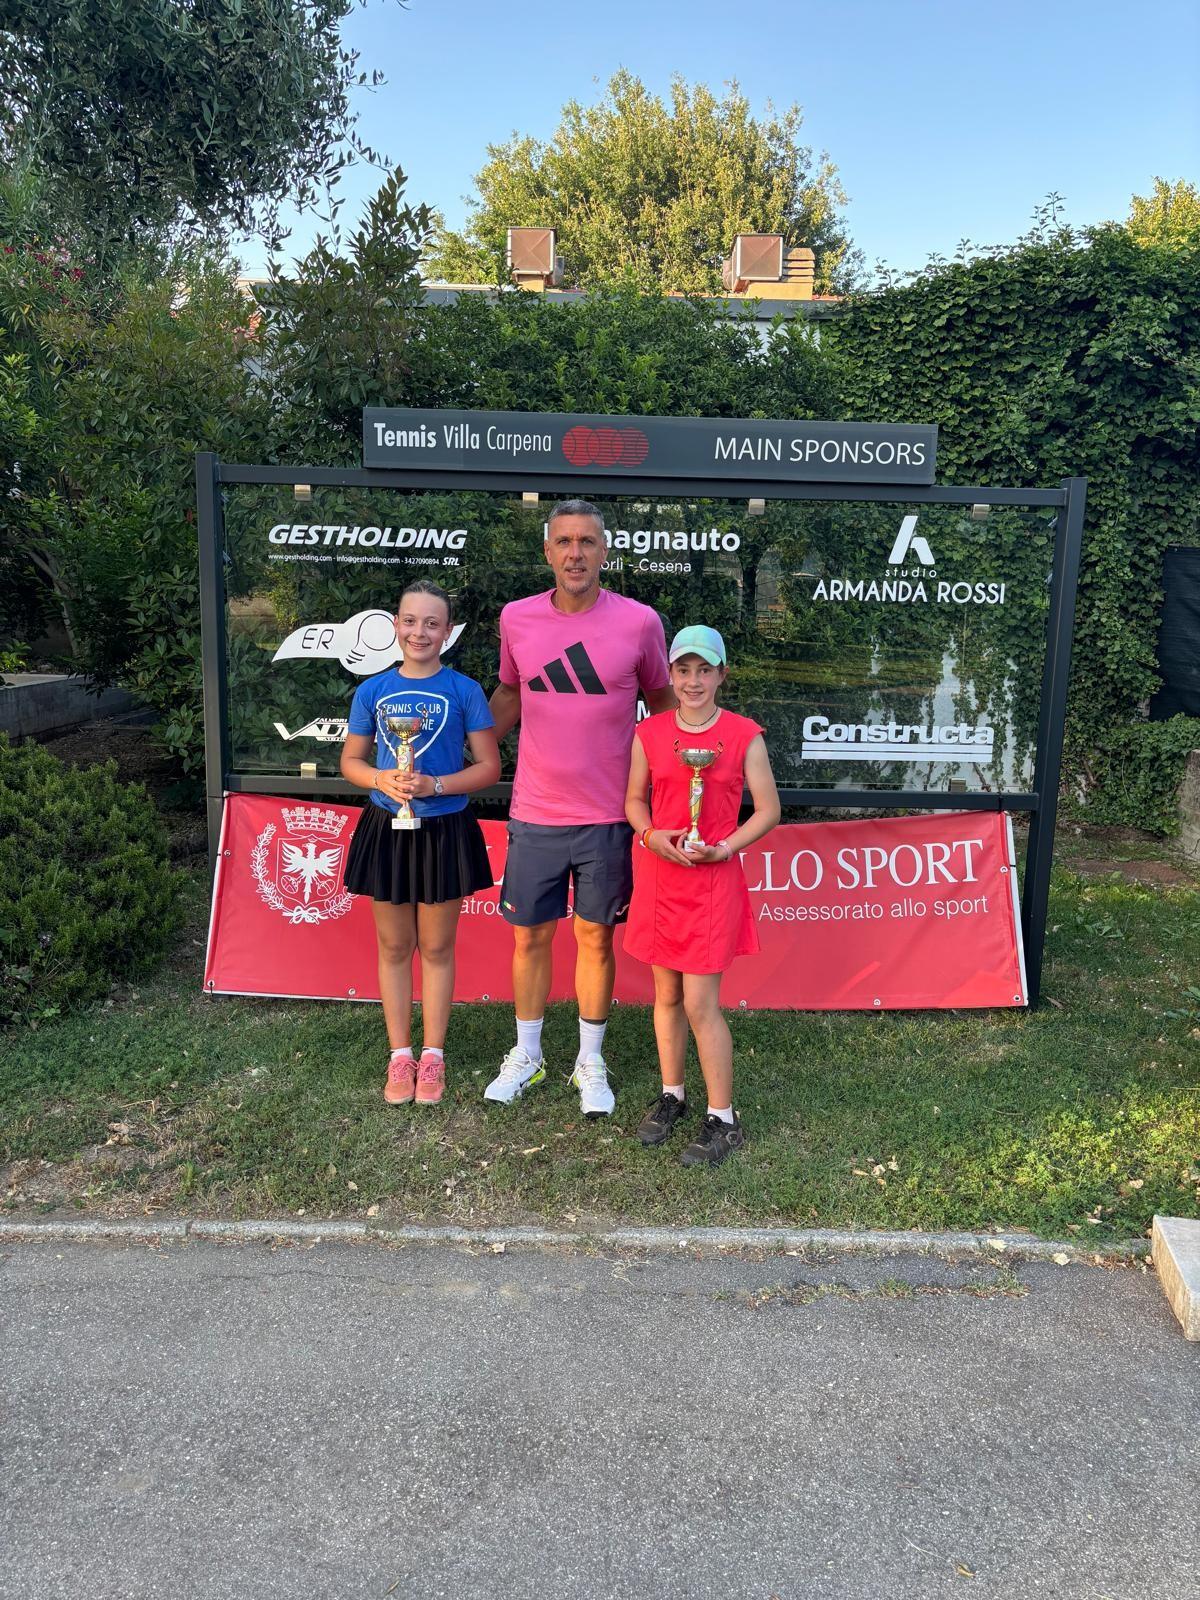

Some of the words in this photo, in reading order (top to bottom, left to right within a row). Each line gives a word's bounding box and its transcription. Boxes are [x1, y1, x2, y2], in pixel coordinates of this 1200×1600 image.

[373, 422, 437, 448] Tennis
[443, 423, 480, 449] Villa
[486, 425, 552, 457] Carpena
[714, 436, 782, 461] MAIN
[789, 438, 926, 466] SPONSORS
[268, 524, 468, 549] GESTHOLDING
[544, 523, 741, 554] agnauto
[442, 556, 460, 566] SRL
[601, 557, 624, 571] orlì
[639, 558, 692, 573] Cesena
[885, 567, 937, 578] studio
[812, 579, 928, 602] ARMANDA
[937, 581, 1006, 604] ROSSI
[302, 628, 334, 650] ER
[802, 715, 994, 745] Constructa
[836, 839, 984, 890] SPORT
[758, 901, 884, 922] Assessorato
[890, 897, 927, 919] allo
[933, 895, 989, 919] sport
